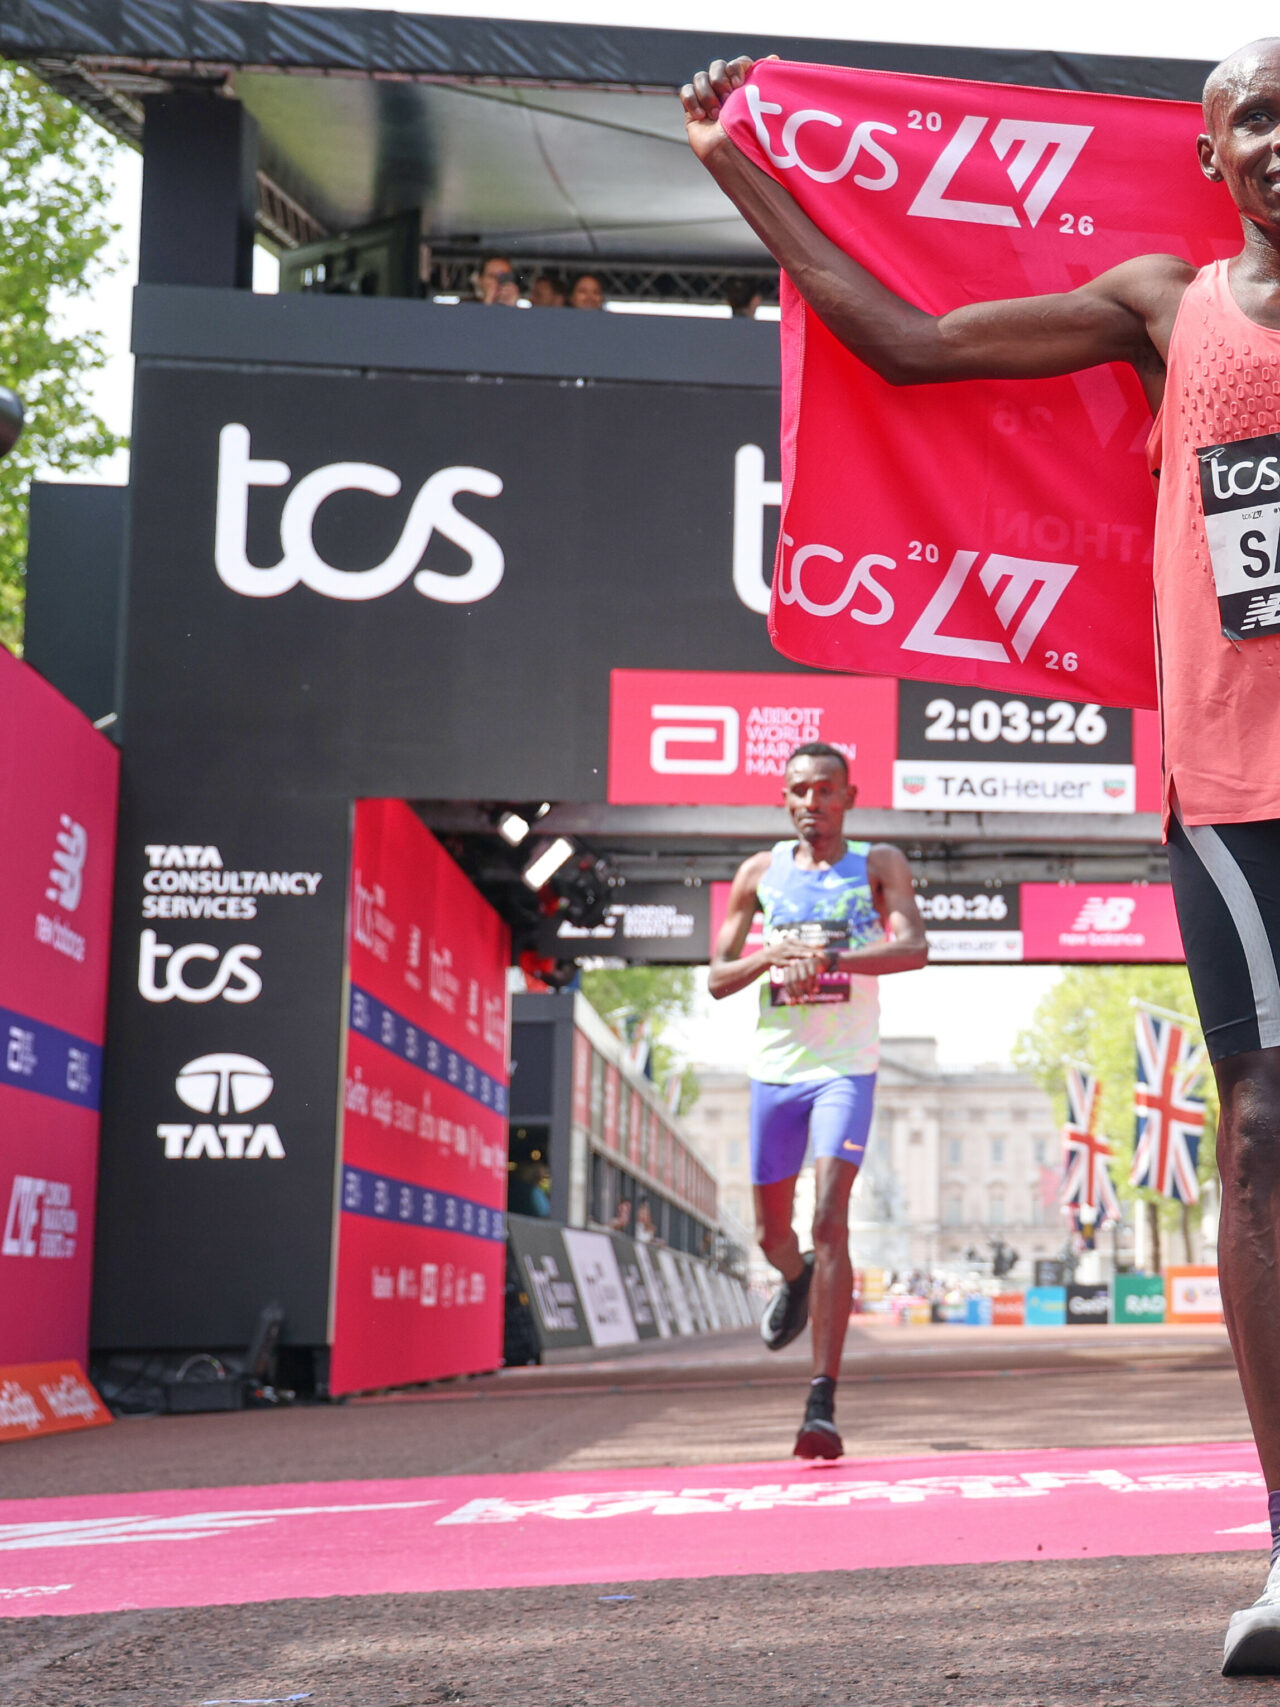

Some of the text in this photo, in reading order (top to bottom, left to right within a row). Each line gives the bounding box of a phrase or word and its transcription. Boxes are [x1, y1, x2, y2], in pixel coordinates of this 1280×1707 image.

[745, 84, 899, 191] tcs
[907, 109, 942, 132] 20
[1059, 213, 1094, 236] 26
[1211, 457, 1280, 499] tcs
[215, 422, 505, 604] tcs
[907, 540, 939, 563] 20
[1045, 651, 1078, 672] 26
[746, 725, 820, 742] WORLD
[748, 707, 823, 725] ABBOTT
[925, 699, 1107, 745] 2:03:26
[144, 845, 223, 868] TATA
[143, 870, 322, 895] CONSULTANCY
[142, 896, 257, 919] SERVICES
[138, 928, 262, 1003] tcs
[156, 1124, 286, 1159] TATA
